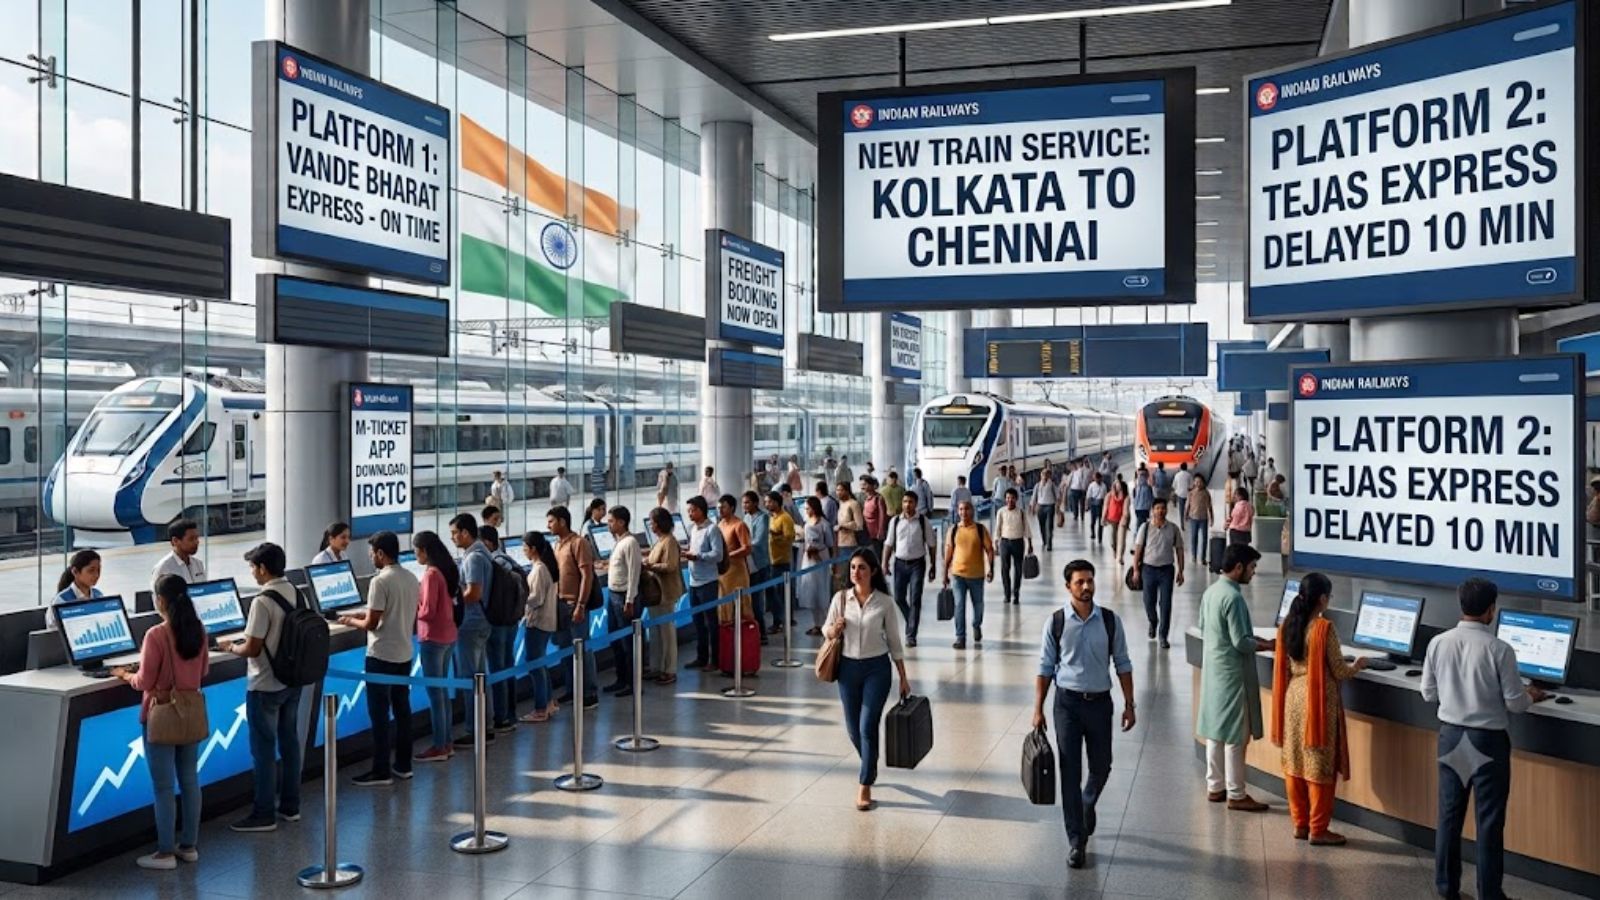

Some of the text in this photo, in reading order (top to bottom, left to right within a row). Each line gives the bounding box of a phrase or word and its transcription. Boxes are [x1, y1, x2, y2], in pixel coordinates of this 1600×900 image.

[1322, 63, 1382, 90] RAILWAYS
[878, 102, 979, 121] INDIAN RAILWAYS
[1271, 80, 1546, 171] PLATFORM 2:
[292, 97, 438, 176] PLATFORM 1:
[858, 127, 1150, 170] NEW TRAIN SERVICE:
[286, 141, 440, 212] VANDE BHARAT
[873, 166, 1136, 220] KOLKATA TO
[1262, 139, 1558, 222] TEJAS EXPRESS
[287, 184, 364, 226] EXPRESS
[380, 208, 401, 235] ON
[405, 214, 441, 243] TIME
[1264, 198, 1555, 270] DELAYED 10 MIN
[908, 219, 1098, 268] CHENNAI
[728, 256, 777, 289] FREIGHT
[727, 303, 778, 330] NOW OPEN
[728, 280, 777, 310] BOOKING
[356, 419, 407, 435] M-TICKET
[1311, 415, 1552, 456] PLATFORM 2:
[368, 440, 396, 459] APP
[357, 480, 407, 508] IRCTC
[1304, 463, 1560, 508] TEJAS EXPRESS
[1304, 507, 1559, 559] DELAYED 10 MIN
